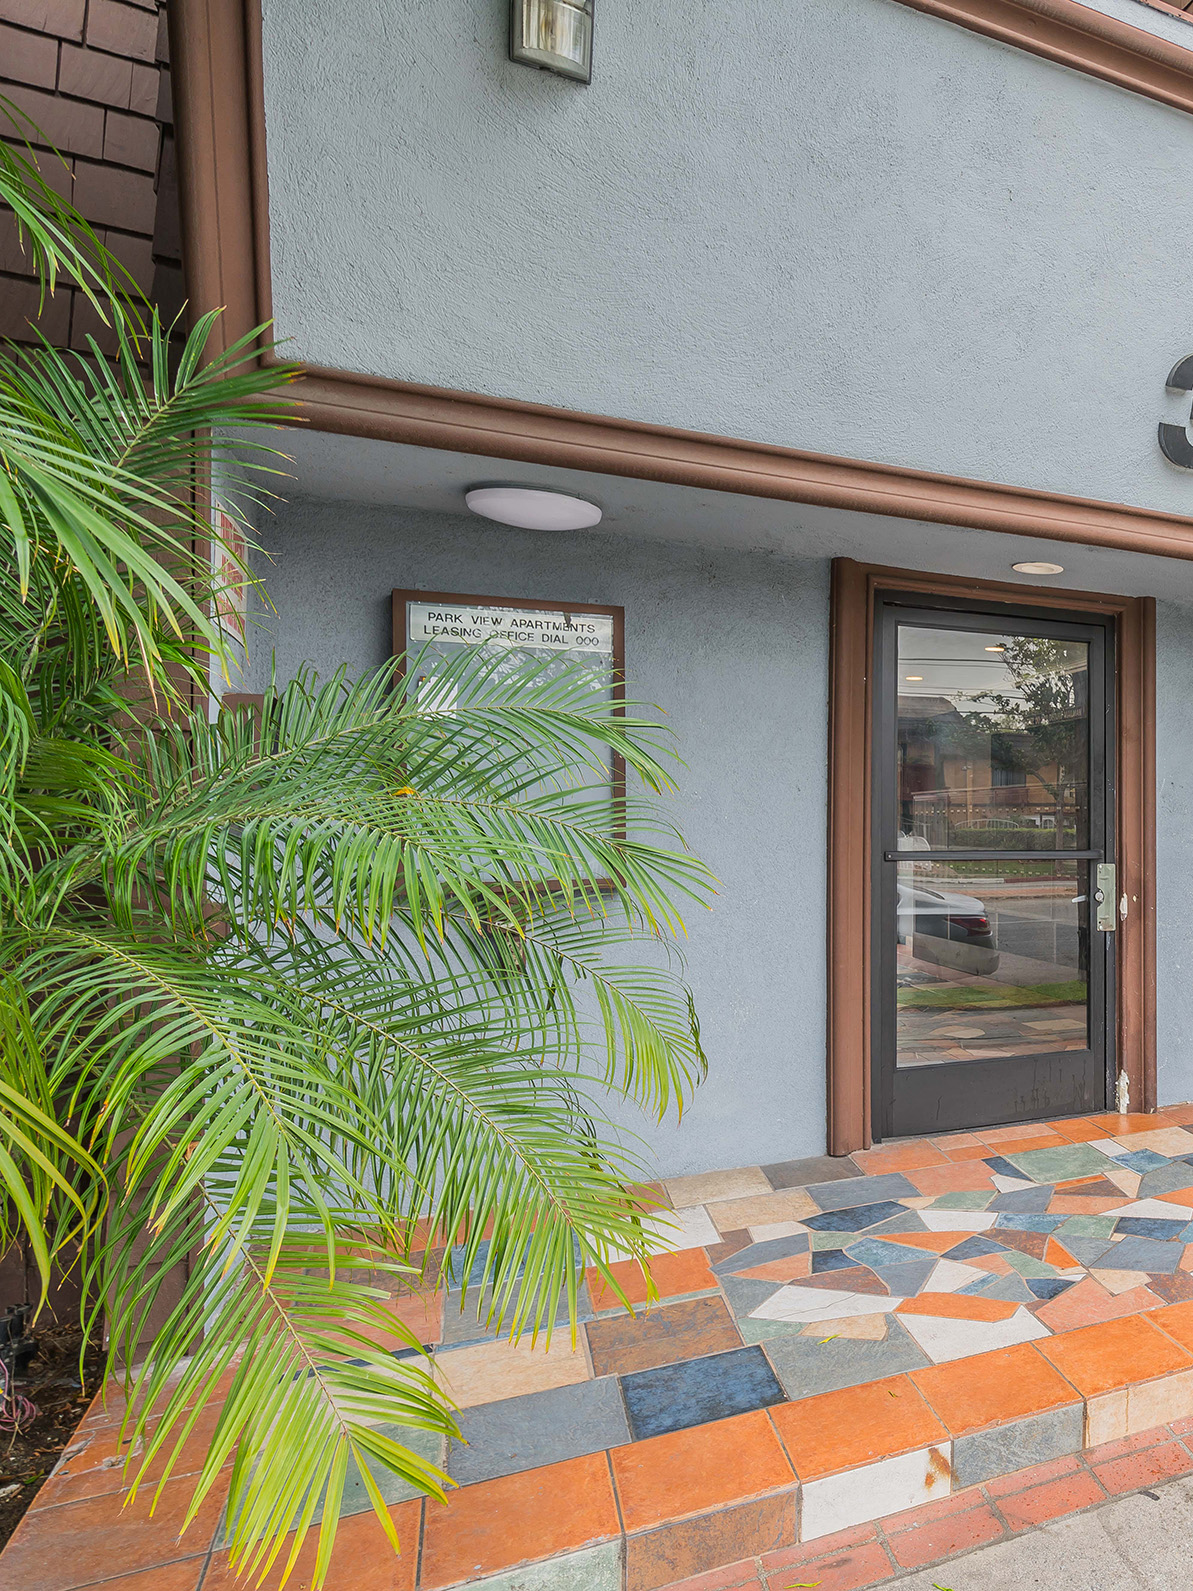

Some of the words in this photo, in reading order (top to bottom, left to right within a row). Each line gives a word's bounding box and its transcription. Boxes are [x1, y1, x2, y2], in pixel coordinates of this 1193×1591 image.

[427, 612, 463, 624] PARK
[471, 615, 503, 626] VIEW
[510, 618, 596, 634] APARTMENTS
[423, 625, 482, 638] LEASING
[541, 633, 569, 644] DIAL
